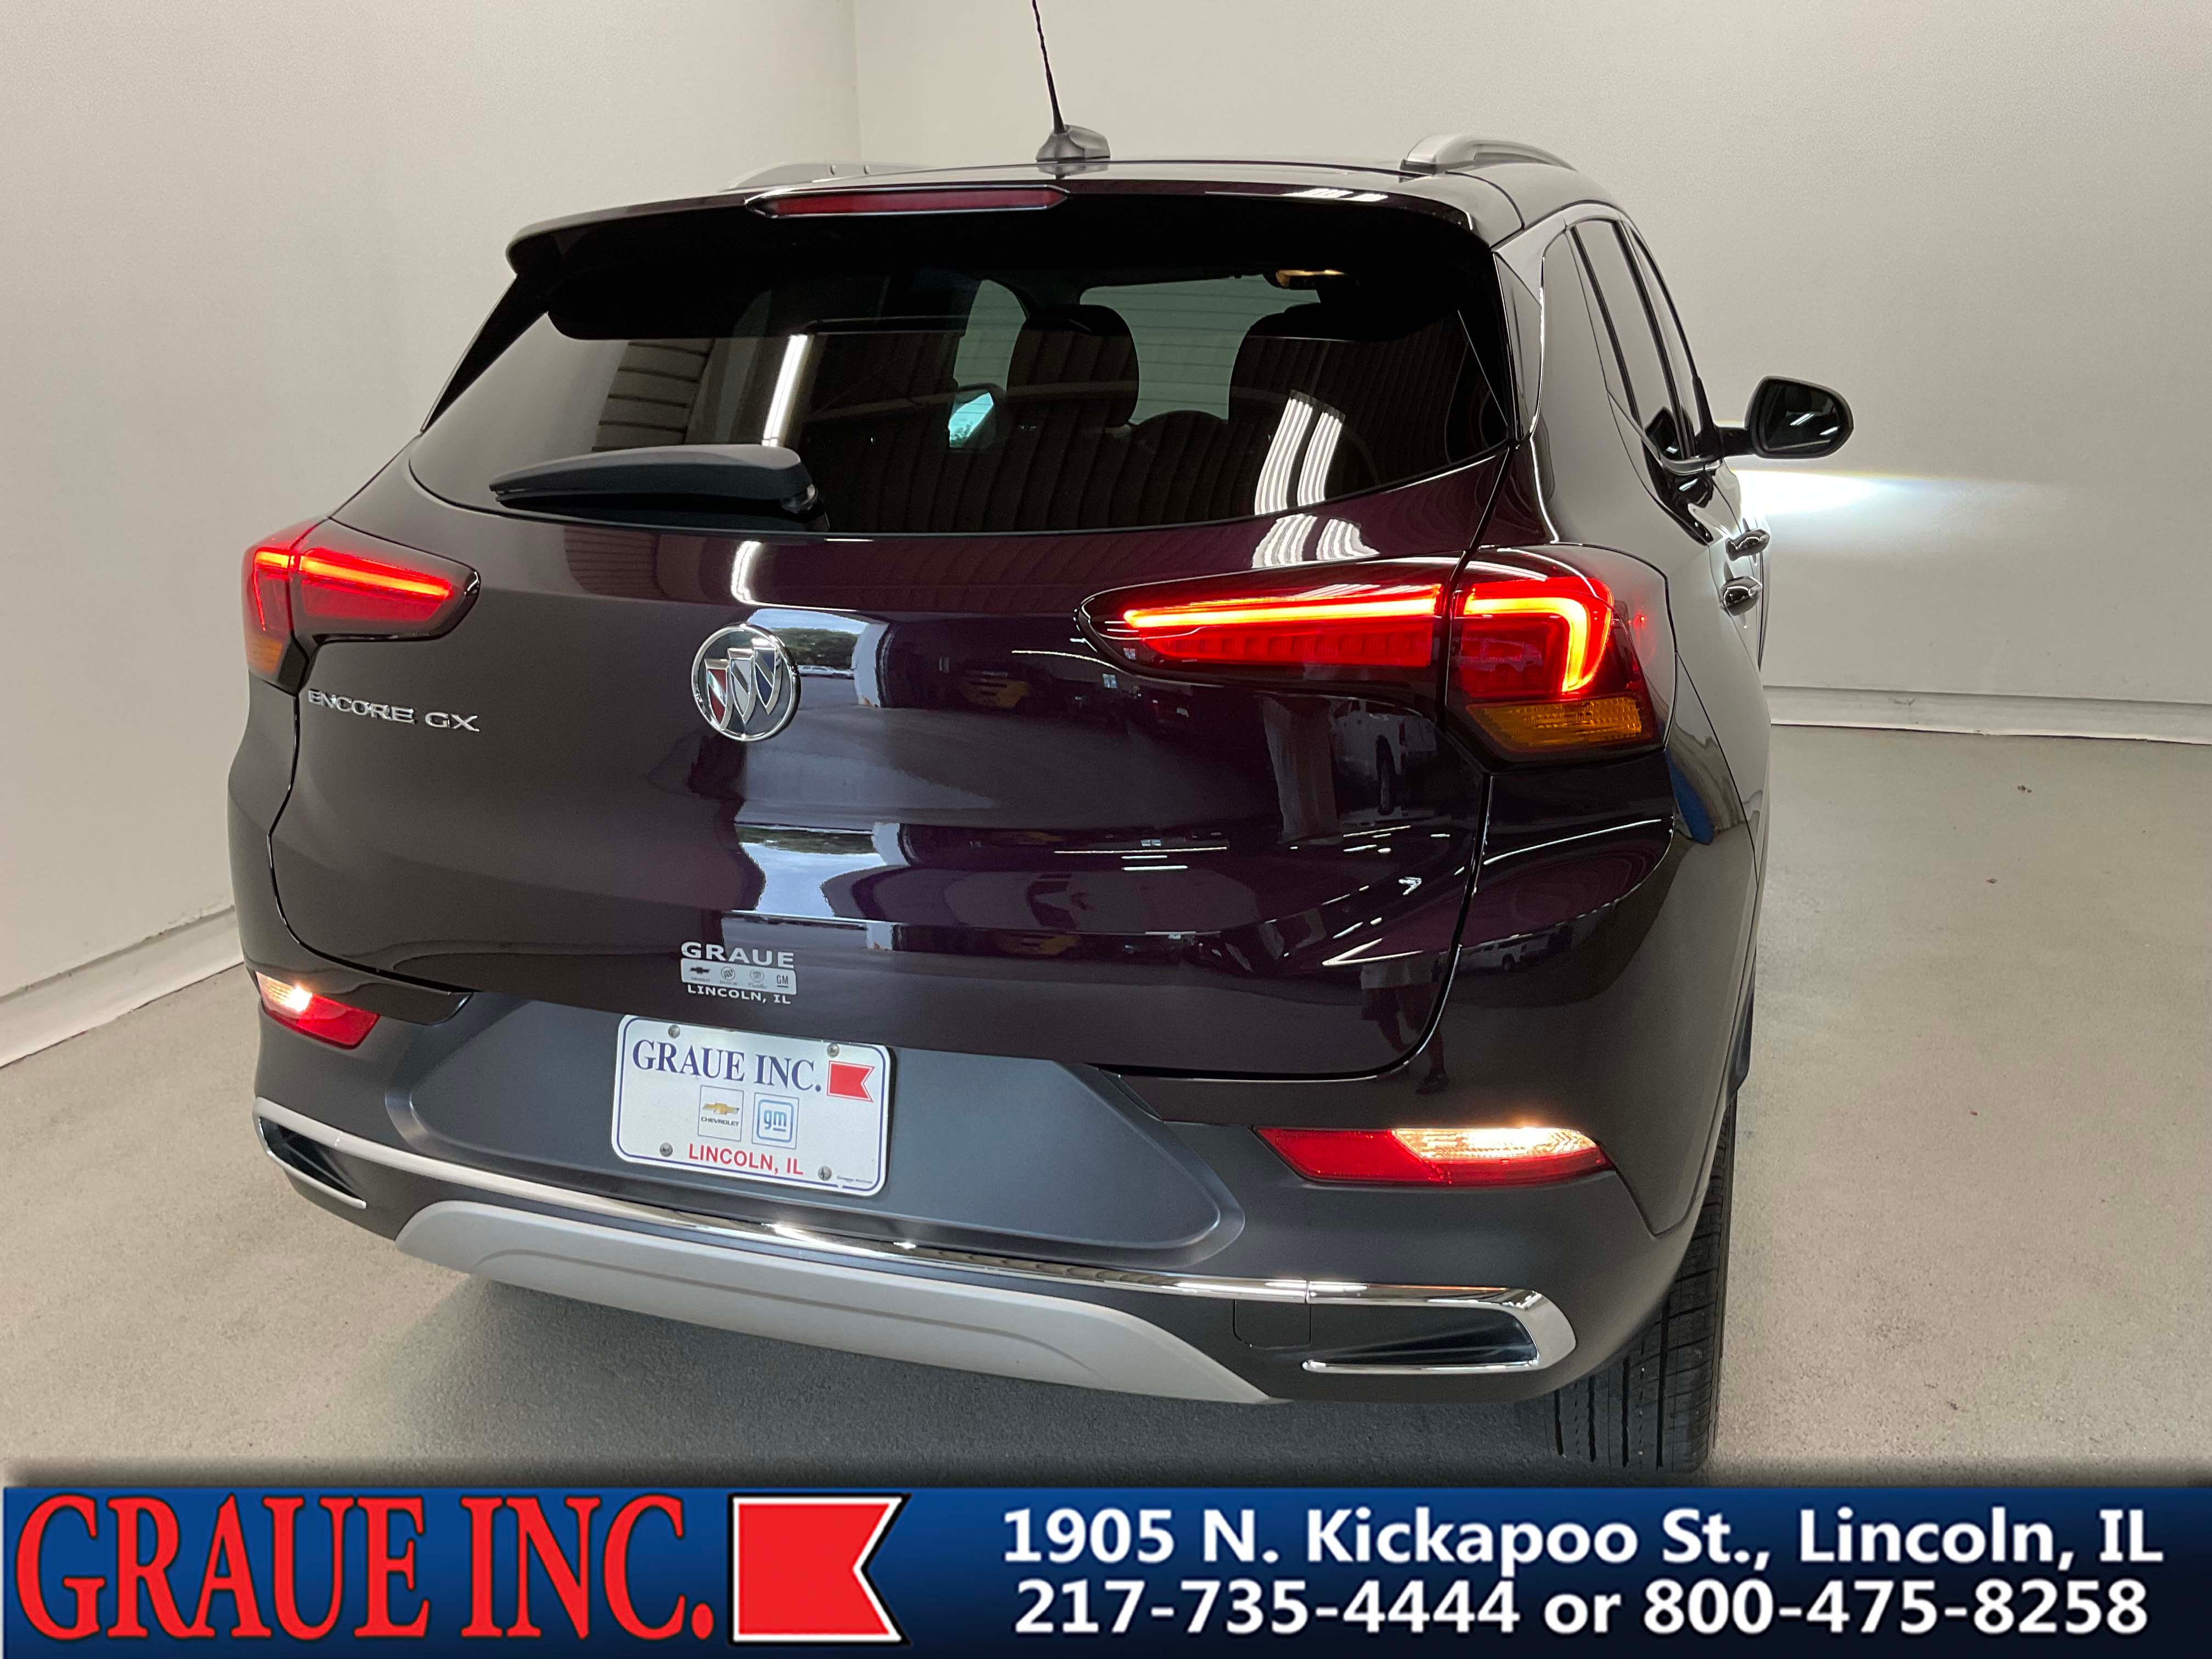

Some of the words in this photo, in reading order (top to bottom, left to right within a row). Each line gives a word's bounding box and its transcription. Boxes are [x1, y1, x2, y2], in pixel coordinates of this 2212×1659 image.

[308, 689, 415, 724] ENCORE
[425, 712, 480, 732] GX
[681, 941, 794, 968] GRAUE
[776, 974, 789, 985] GM
[687, 984, 766, 1003] LINCOLN,
[774, 994, 791, 1005] IL
[633, 1039, 746, 1082] GRAUE
[754, 1053, 821, 1092] INC.
[701, 1116, 740, 1126] CHEVROLET
[764, 1110, 787, 1130] gm
[689, 1143, 778, 1173] LINCOLN,
[787, 1157, 804, 1175] IL
